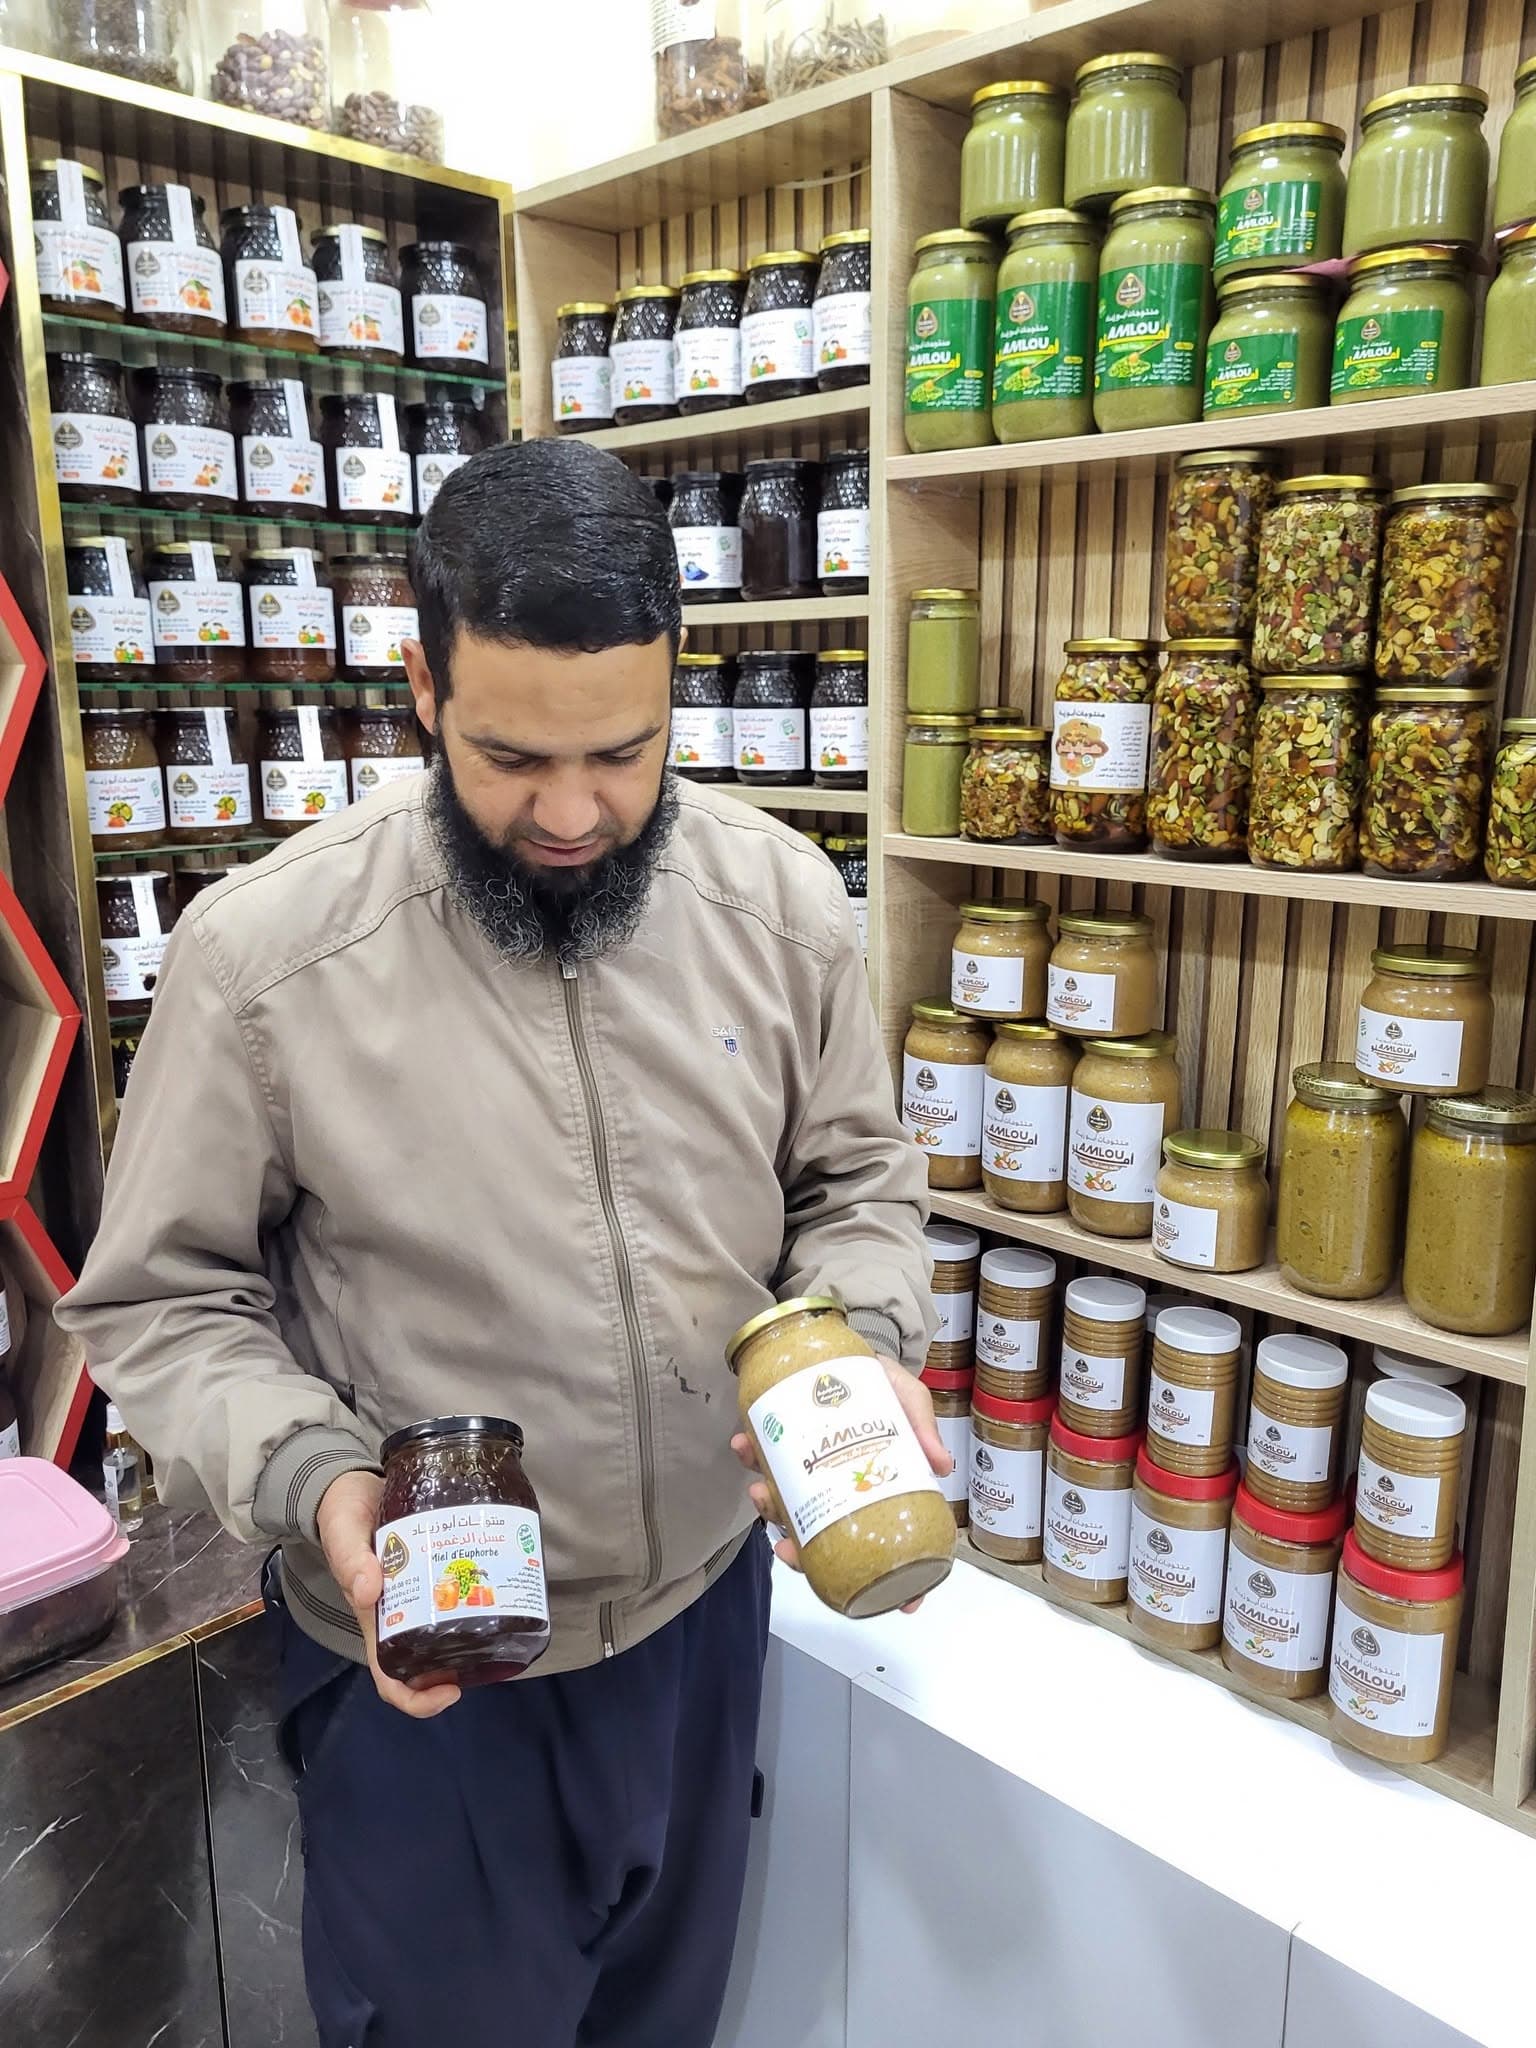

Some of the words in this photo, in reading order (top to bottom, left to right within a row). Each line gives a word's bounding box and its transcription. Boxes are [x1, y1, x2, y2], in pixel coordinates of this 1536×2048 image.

[1236, 215, 1274, 231] AMLOU
[1107, 320, 1160, 340] AMLOU
[1002, 336, 1050, 355] AMLOU
[1352, 346, 1393, 360] AMLOU
[910, 351, 951, 366] AMLOU
[1218, 367, 1252, 381] AMLOU
[1379, 1043, 1411, 1055] AMLOU
[909, 1101, 949, 1117] AMLOU
[988, 1123, 1029, 1140] AMLOU
[1079, 1142, 1125, 1160] AMLOU
[820, 1418, 886, 1453] AMLOU
[1258, 1440, 1290, 1457] AMLOU
[972, 1477, 1006, 1499] AMLOU
[1369, 1491, 1406, 1509] AMLOU
[478, 1531, 506, 1544] عسل
[1054, 1521, 1099, 1542] AMLOU
[451, 1547, 500, 1560] d'Euphorbe
[1139, 1560, 1186, 1584] AMLOU
[1238, 1603, 1290, 1629] AMLOU
[1341, 1659, 1395, 1690] AMLOU
